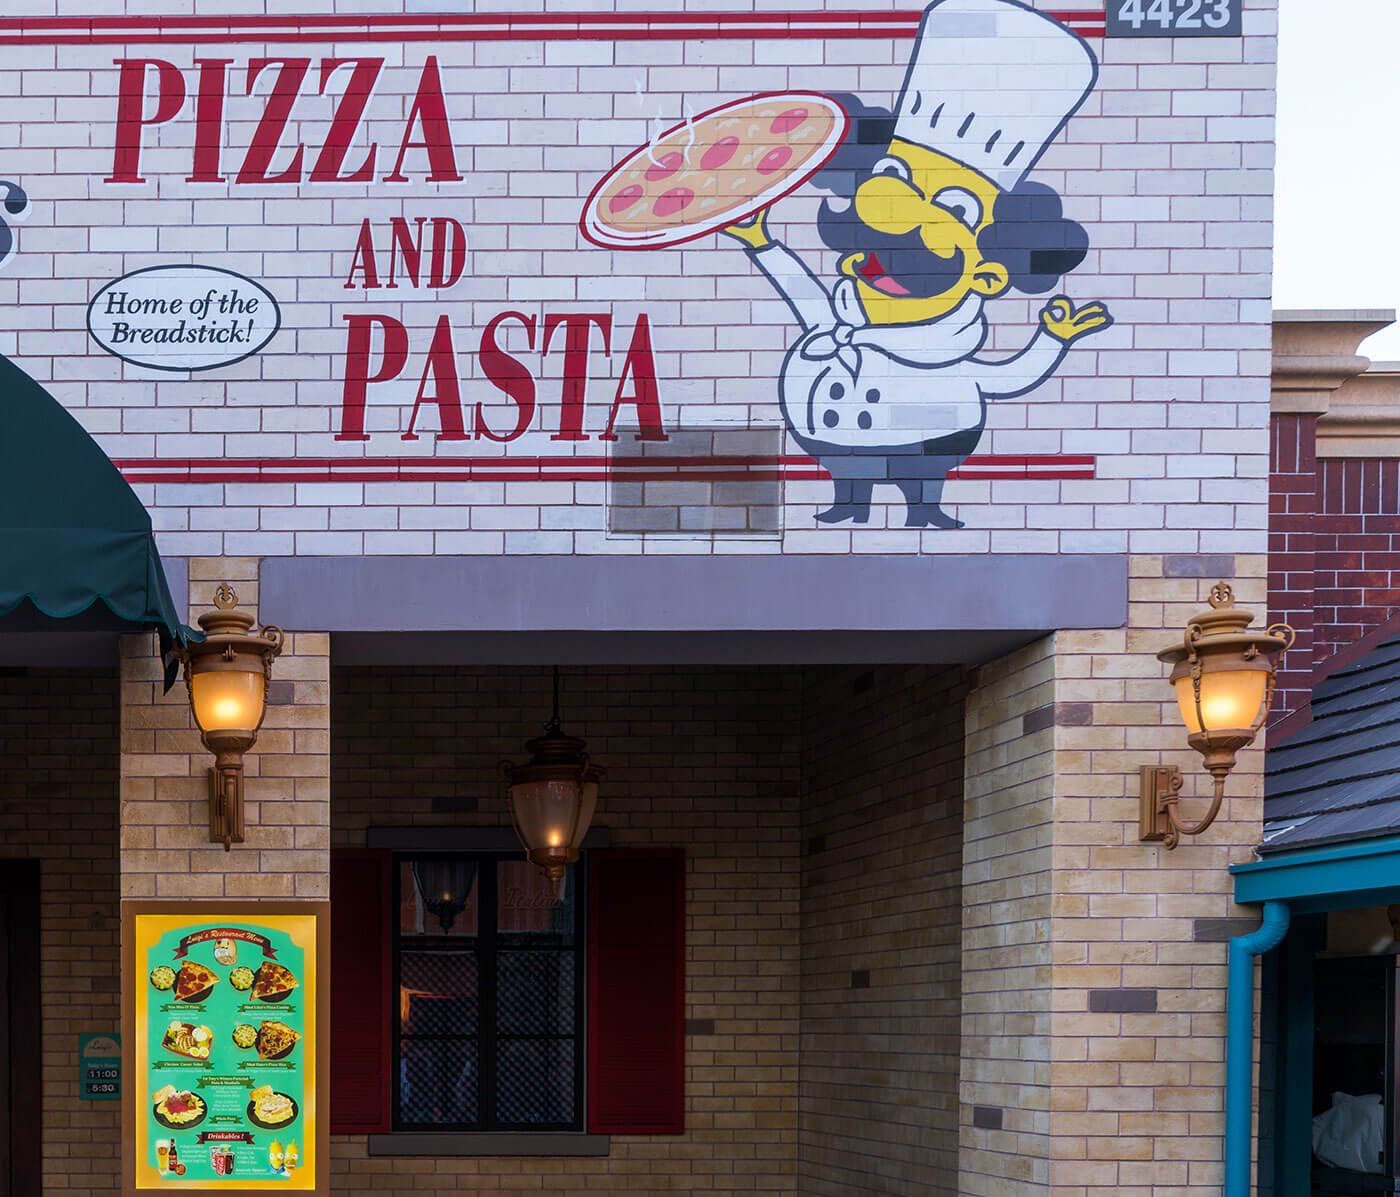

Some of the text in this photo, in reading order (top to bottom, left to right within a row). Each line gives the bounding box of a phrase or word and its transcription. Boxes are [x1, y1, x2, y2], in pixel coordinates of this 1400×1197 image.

[1118, 0, 1231, 29] 4423
[103, 56, 465, 184] PIZZA
[344, 217, 467, 290] AND
[104, 289, 259, 320] Home of the
[110, 318, 254, 344] Breadstick!
[334, 311, 671, 443] PASTA
[89, 1070, 118, 1078] 11:00
